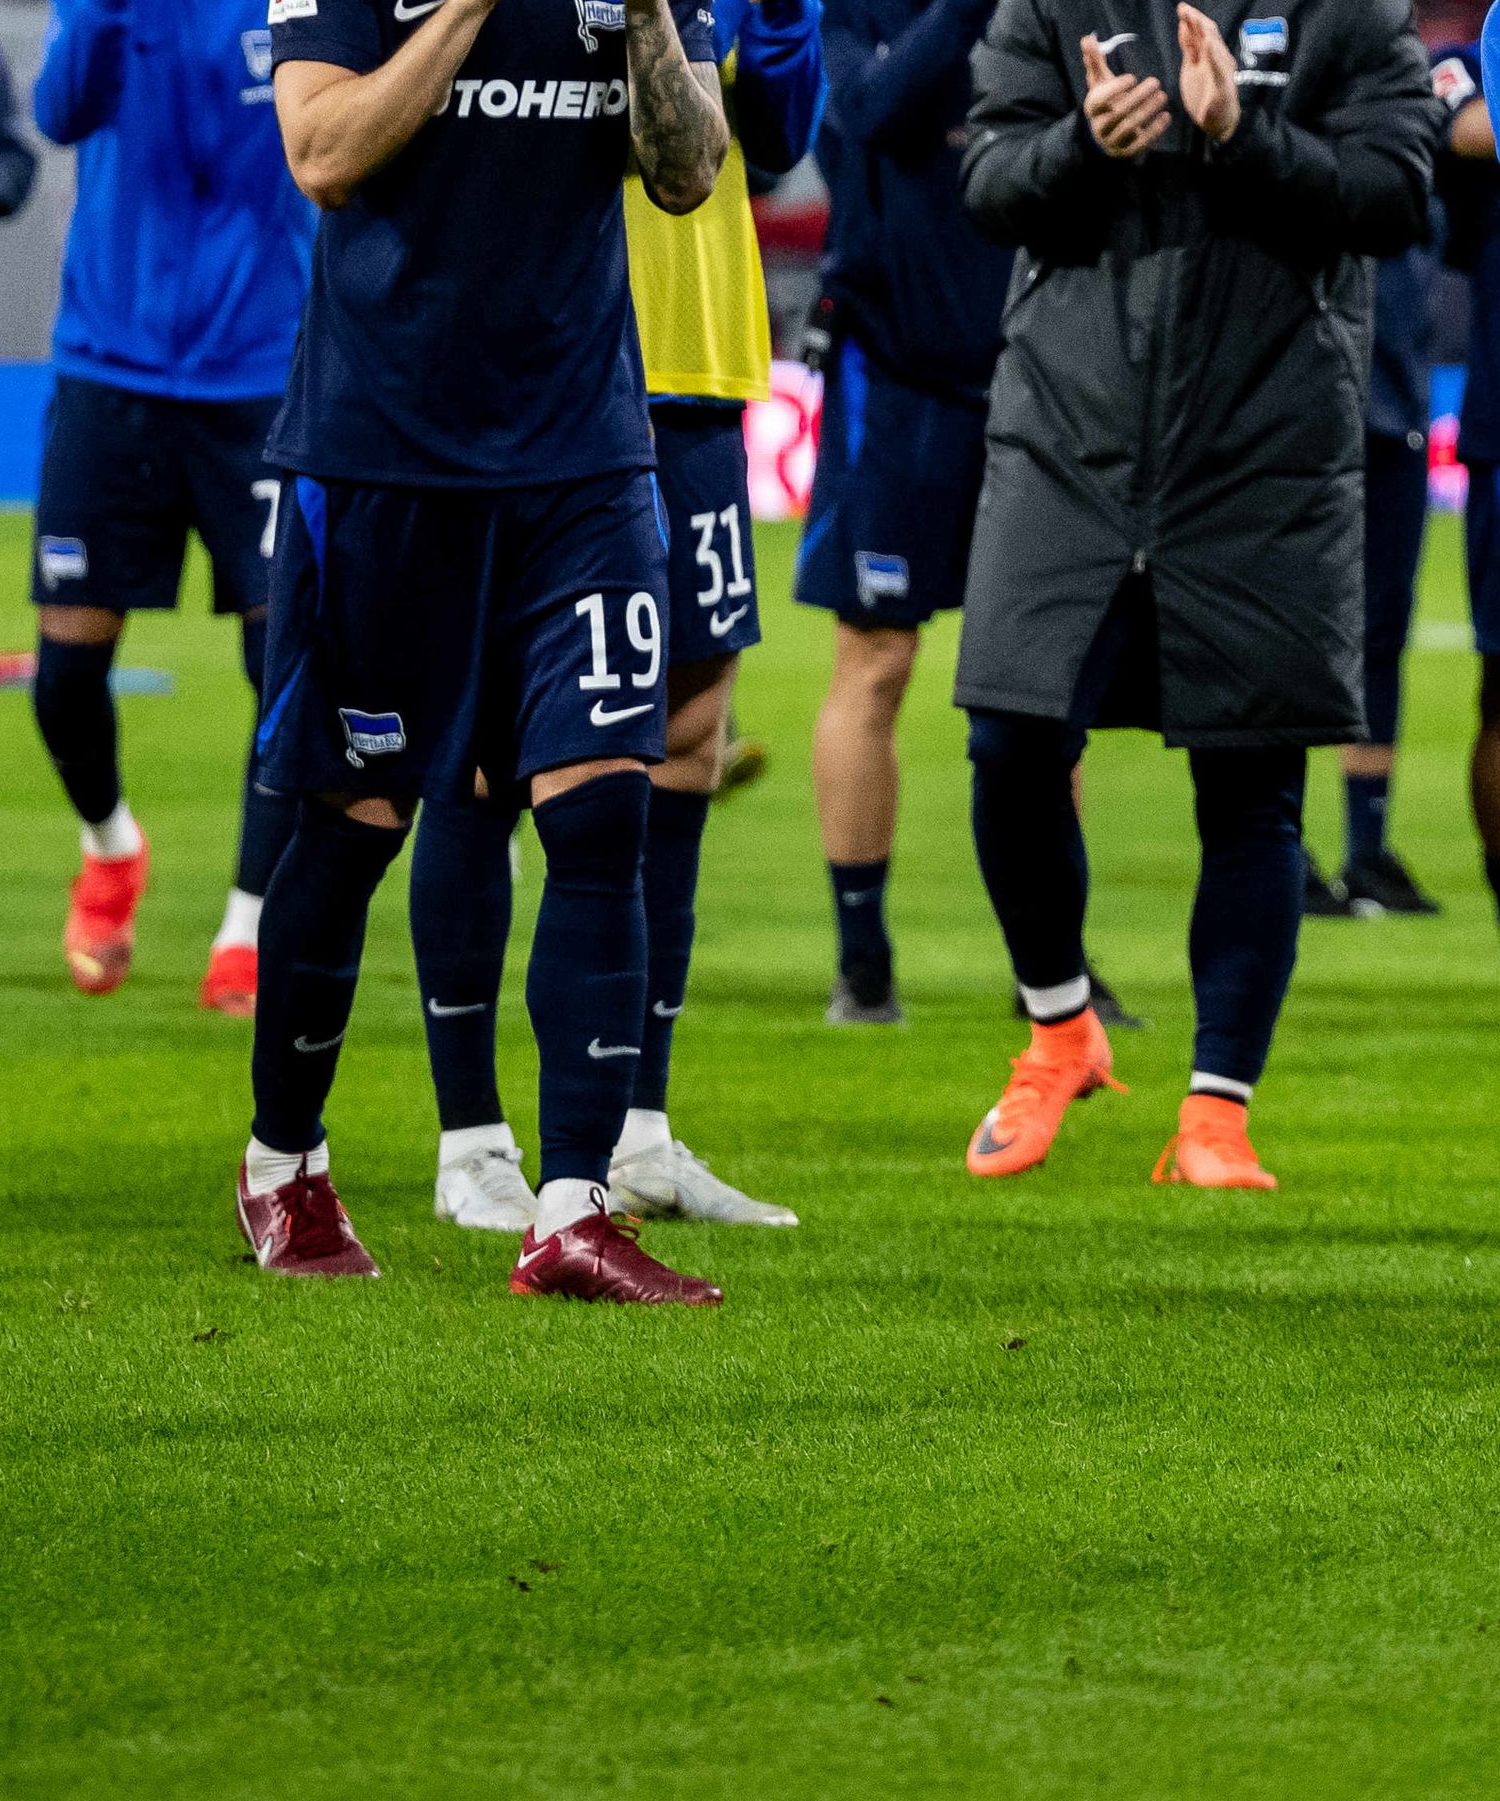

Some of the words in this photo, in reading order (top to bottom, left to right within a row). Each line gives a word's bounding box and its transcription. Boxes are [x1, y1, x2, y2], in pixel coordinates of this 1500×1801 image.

[438, 78, 629, 119] TOHERO
[250, 480, 281, 558] 7
[690, 502, 752, 608] 31
[576, 591, 661, 691] 19
